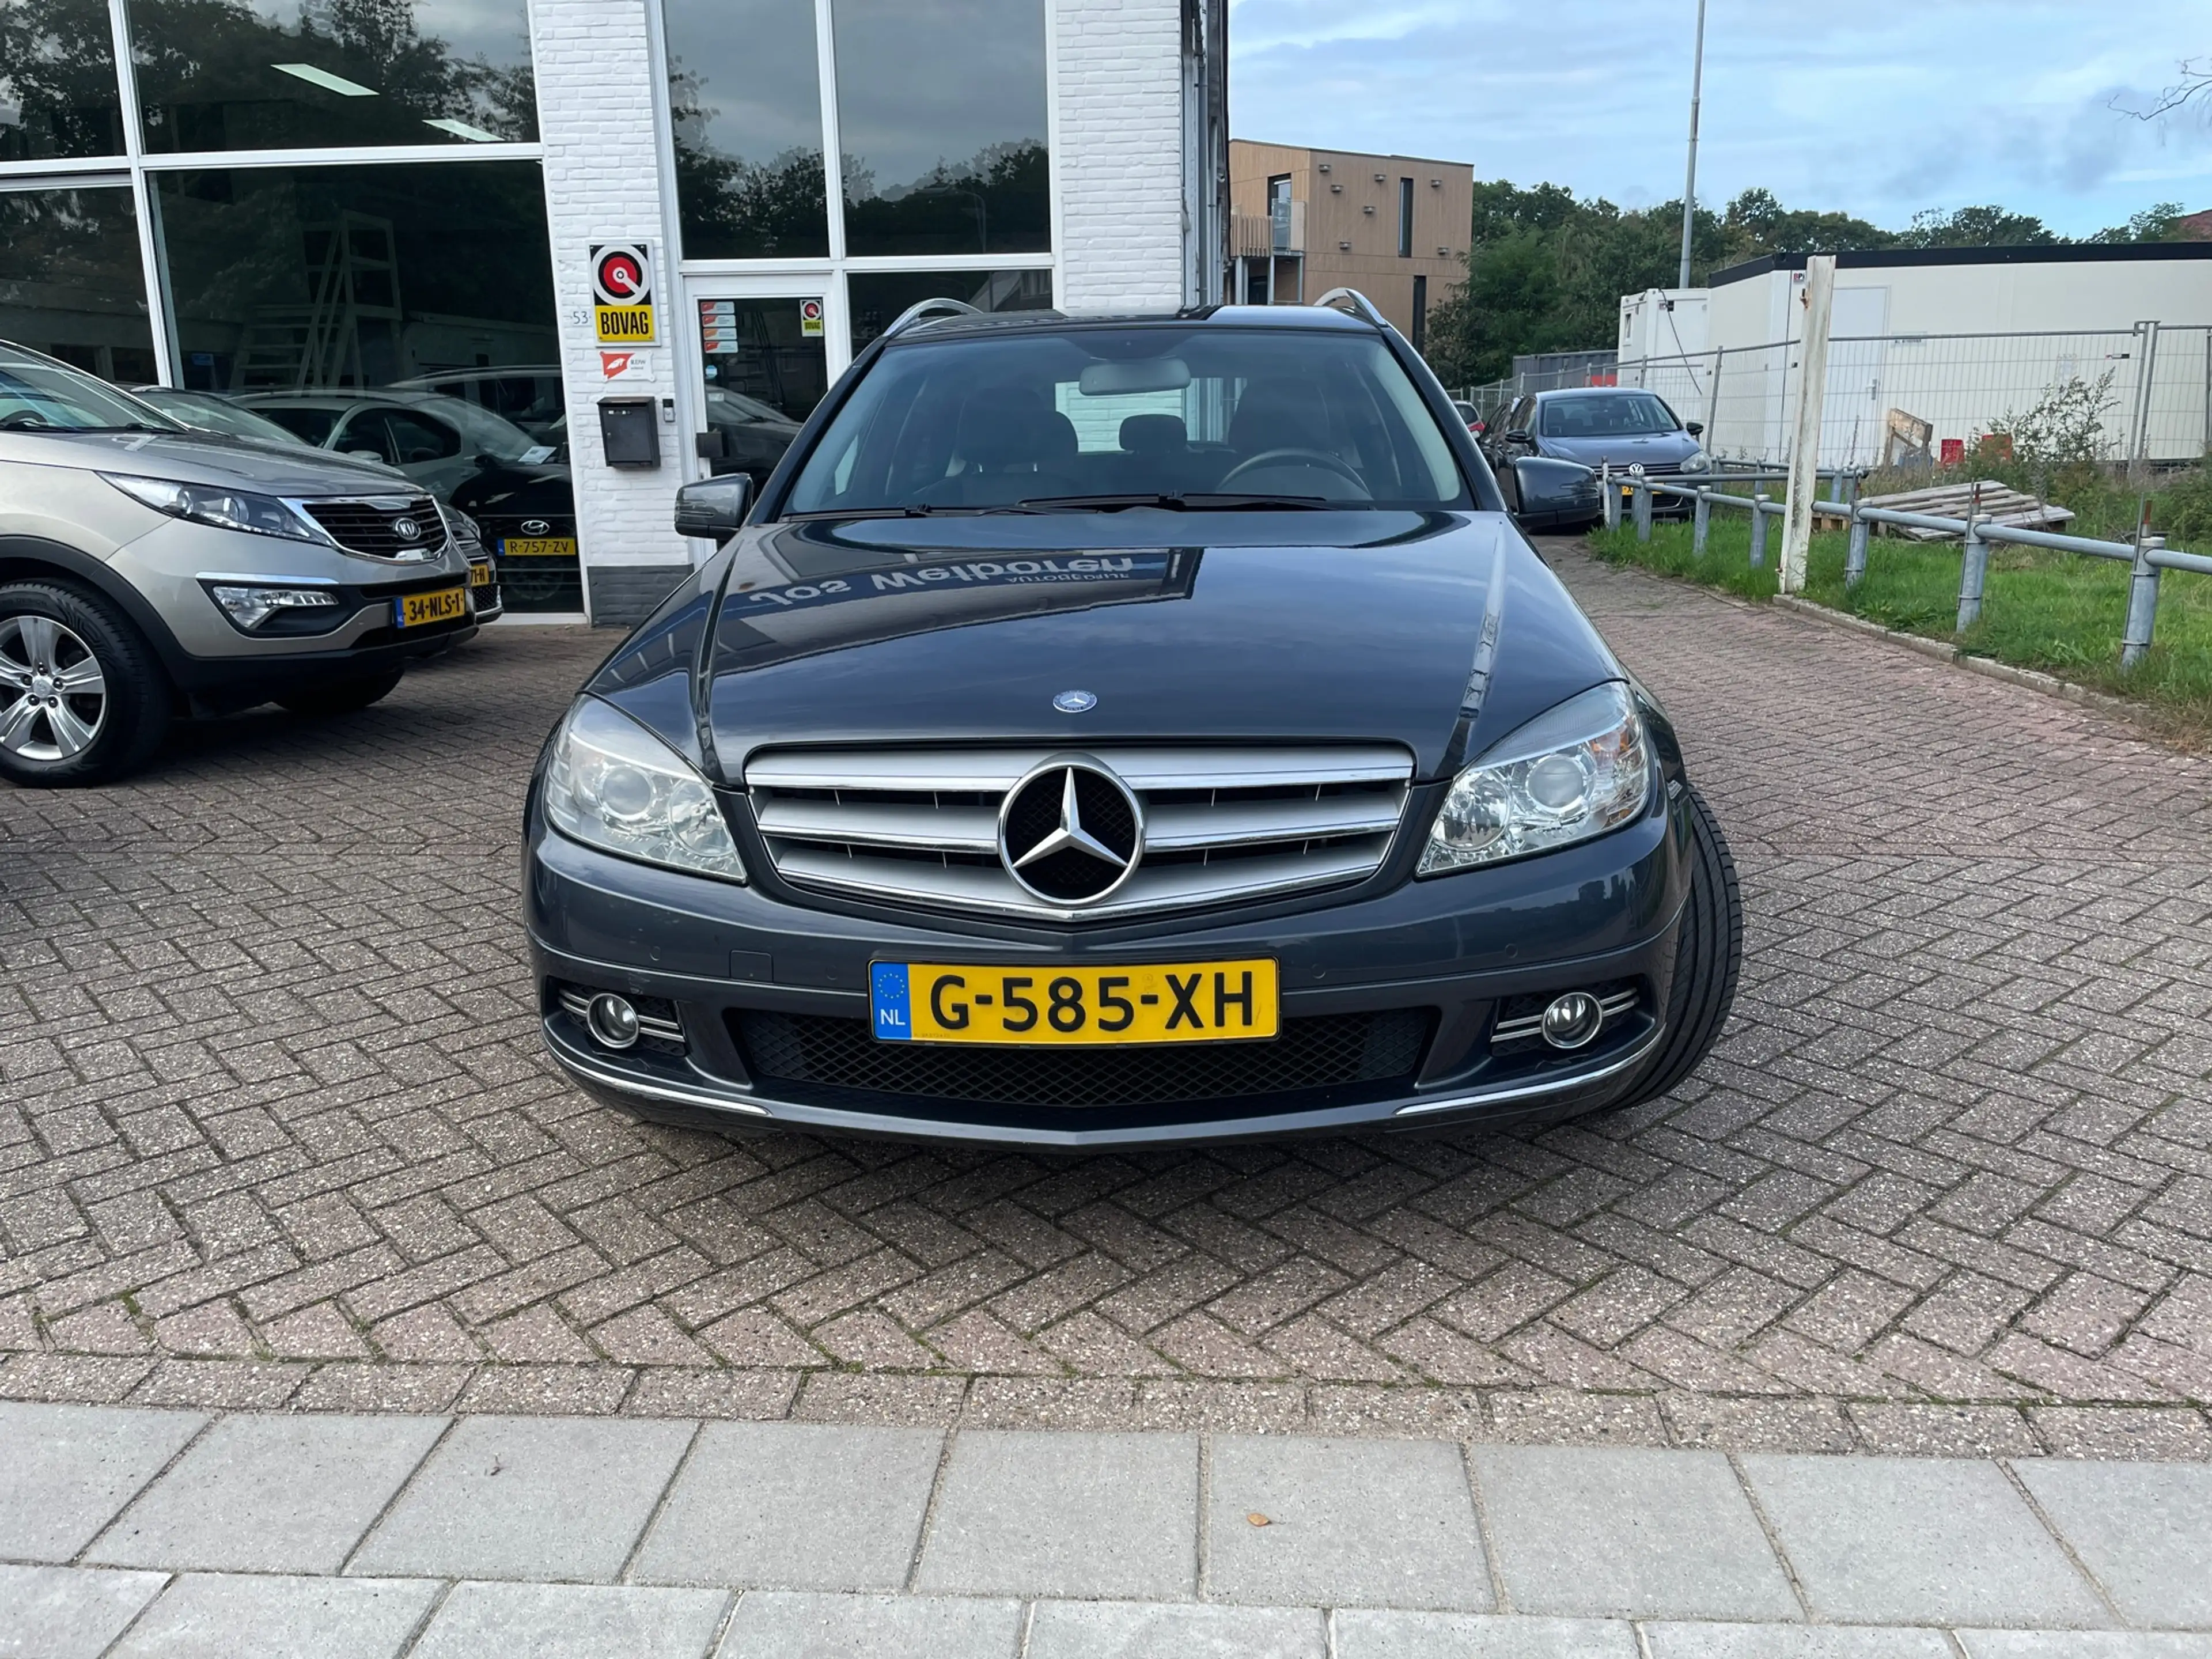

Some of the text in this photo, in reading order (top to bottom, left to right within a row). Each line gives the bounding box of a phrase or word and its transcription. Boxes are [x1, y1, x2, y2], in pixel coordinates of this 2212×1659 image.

[573, 311, 588, 324] 53
[600, 311, 649, 335] BOVAG
[399, 522, 418, 536] KIA
[510, 541, 569, 553] R-757-ZV
[408, 592, 460, 622] 34-NLS-1
[930, 971, 1253, 1032] G-585-XH
[880, 1009, 906, 1025] NL
